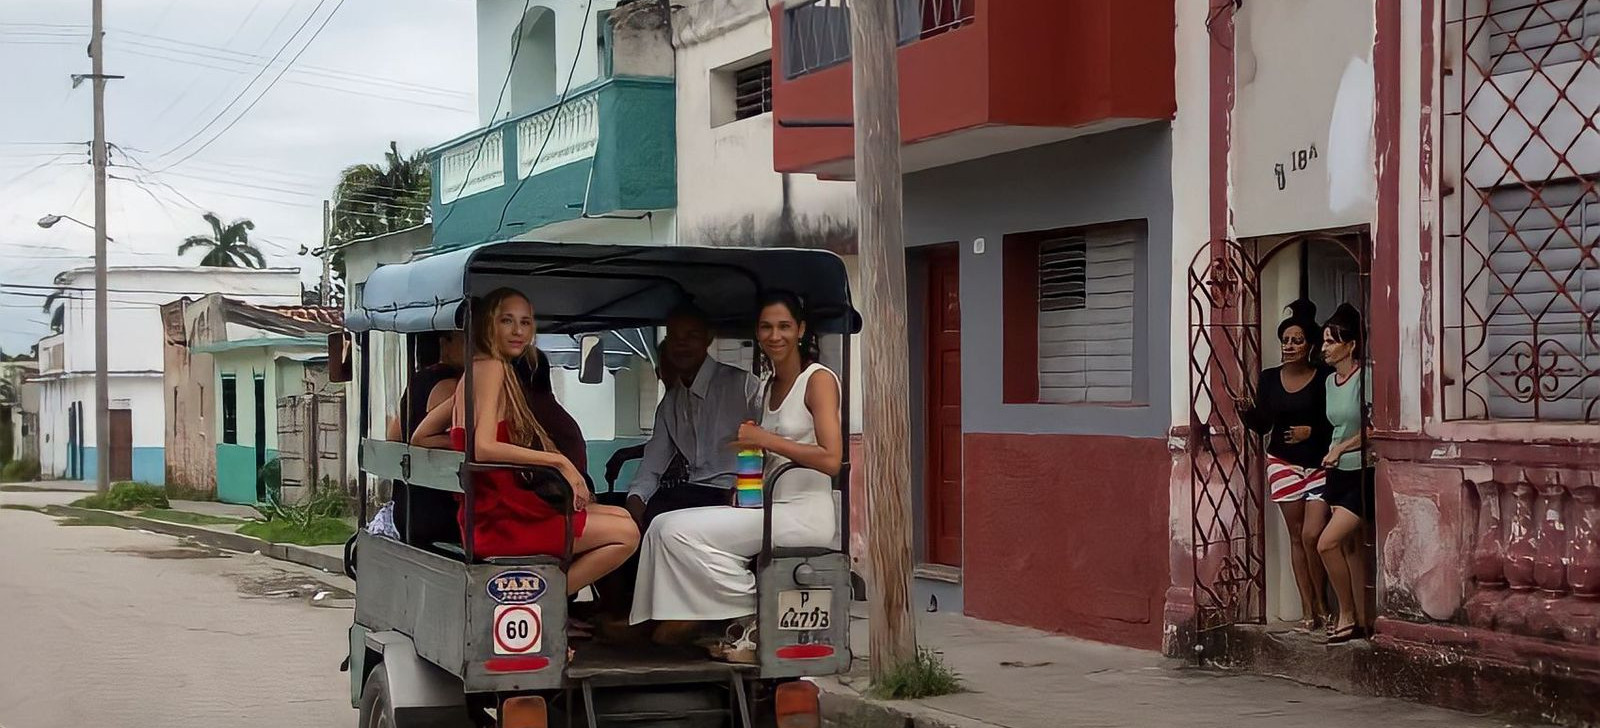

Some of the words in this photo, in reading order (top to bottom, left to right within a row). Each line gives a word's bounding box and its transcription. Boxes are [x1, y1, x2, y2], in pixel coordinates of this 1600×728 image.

[494, 577, 541, 592] TAXI
[800, 591, 809, 608] P
[506, 619, 528, 640] 60
